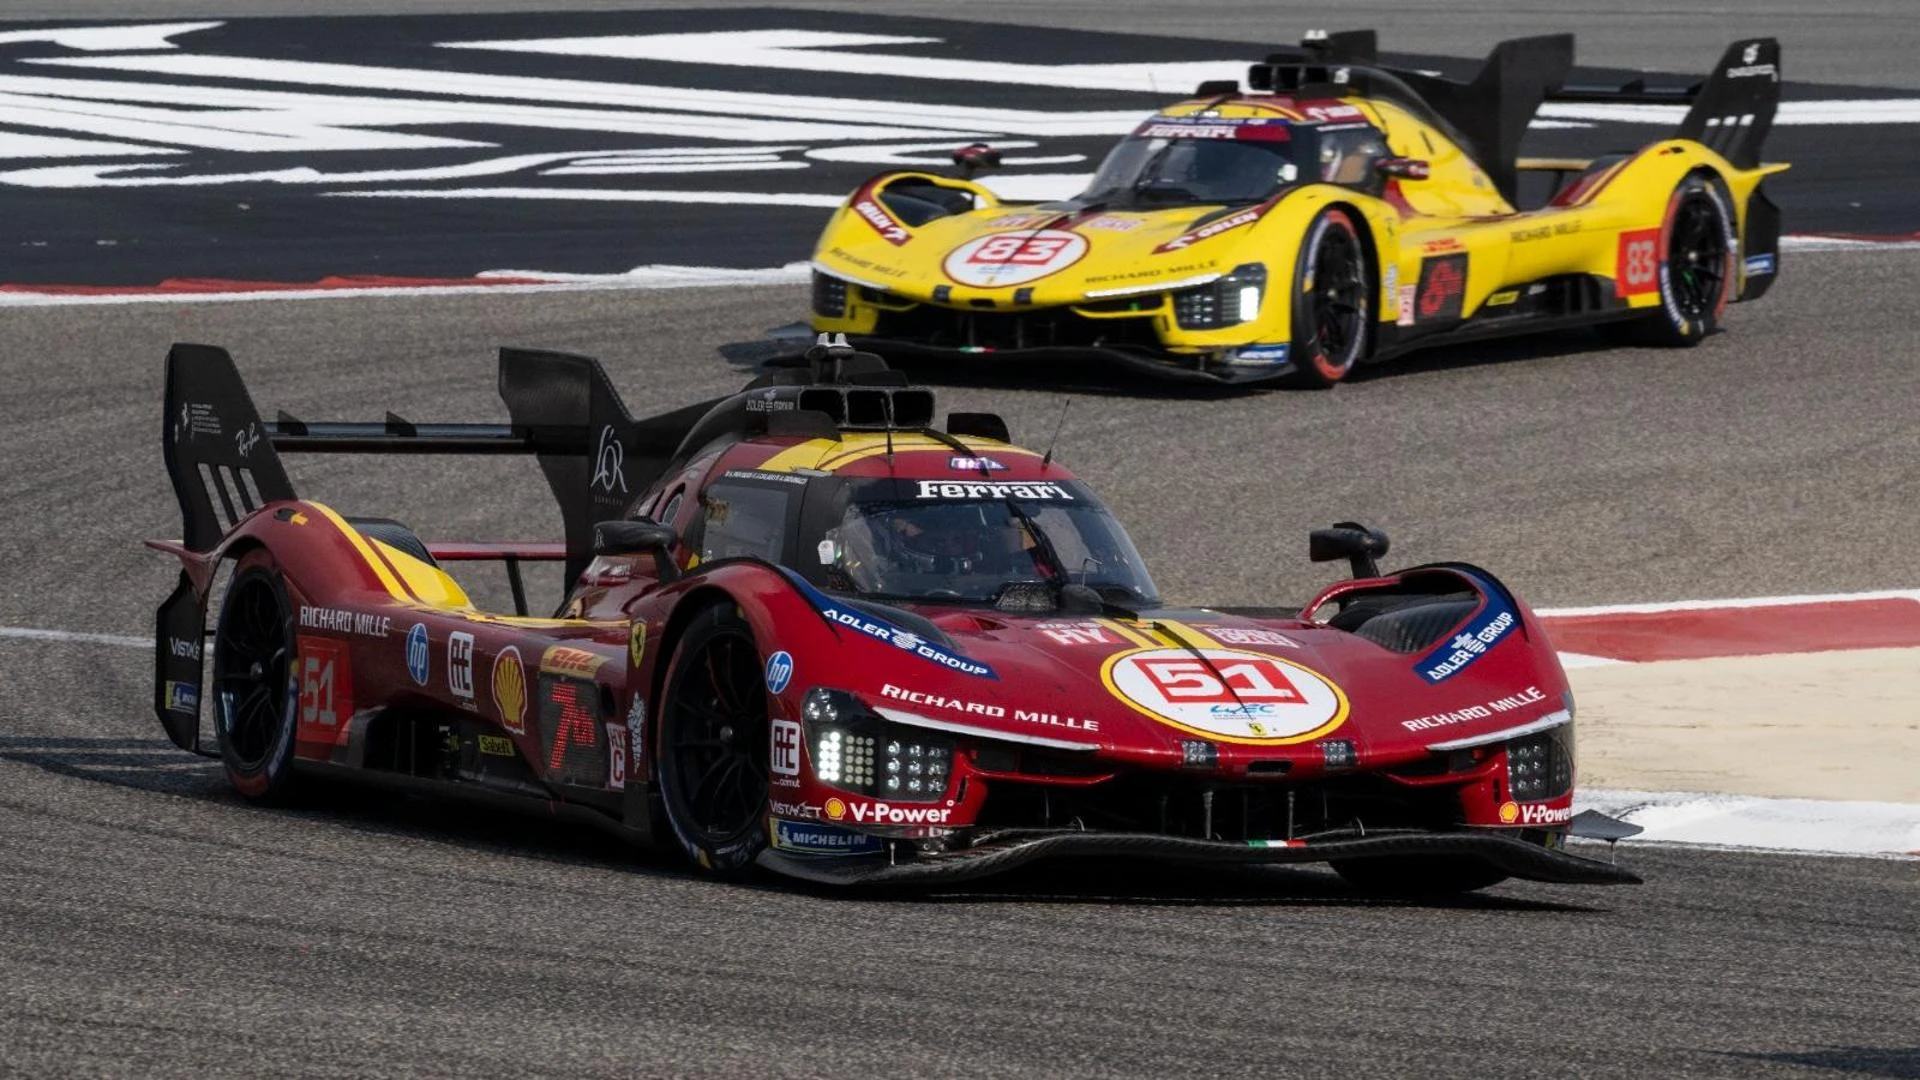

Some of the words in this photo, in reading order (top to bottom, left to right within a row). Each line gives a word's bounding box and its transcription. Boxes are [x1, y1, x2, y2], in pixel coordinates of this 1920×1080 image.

[978, 240, 1062, 260] 83
[1625, 240, 1656, 285] 83
[1084, 269, 1161, 283] RICHARD
[1168, 260, 1219, 273] MILLE
[915, 480, 1075, 500] Ferrari
[300, 606, 351, 633] RICHARD
[354, 612, 391, 638] MILLE
[408, 630, 429, 686] hp
[823, 608, 890, 640] ADLER
[917, 645, 988, 676] GROUP
[1426, 650, 1475, 681] ADLER
[1477, 612, 1514, 644] GROUP
[302, 656, 337, 726] 51
[767, 652, 792, 693] hp
[1145, 661, 1291, 698] 51
[880, 683, 1005, 717] RICHARD
[1014, 709, 1100, 731] MILLE
[1401, 705, 1493, 732] RICHARD
[1488, 685, 1546, 712] MILLE
[850, 802, 952, 823] V-Power
[1521, 804, 1572, 823] V-Powe
[792, 832, 867, 846] MICHELIN
